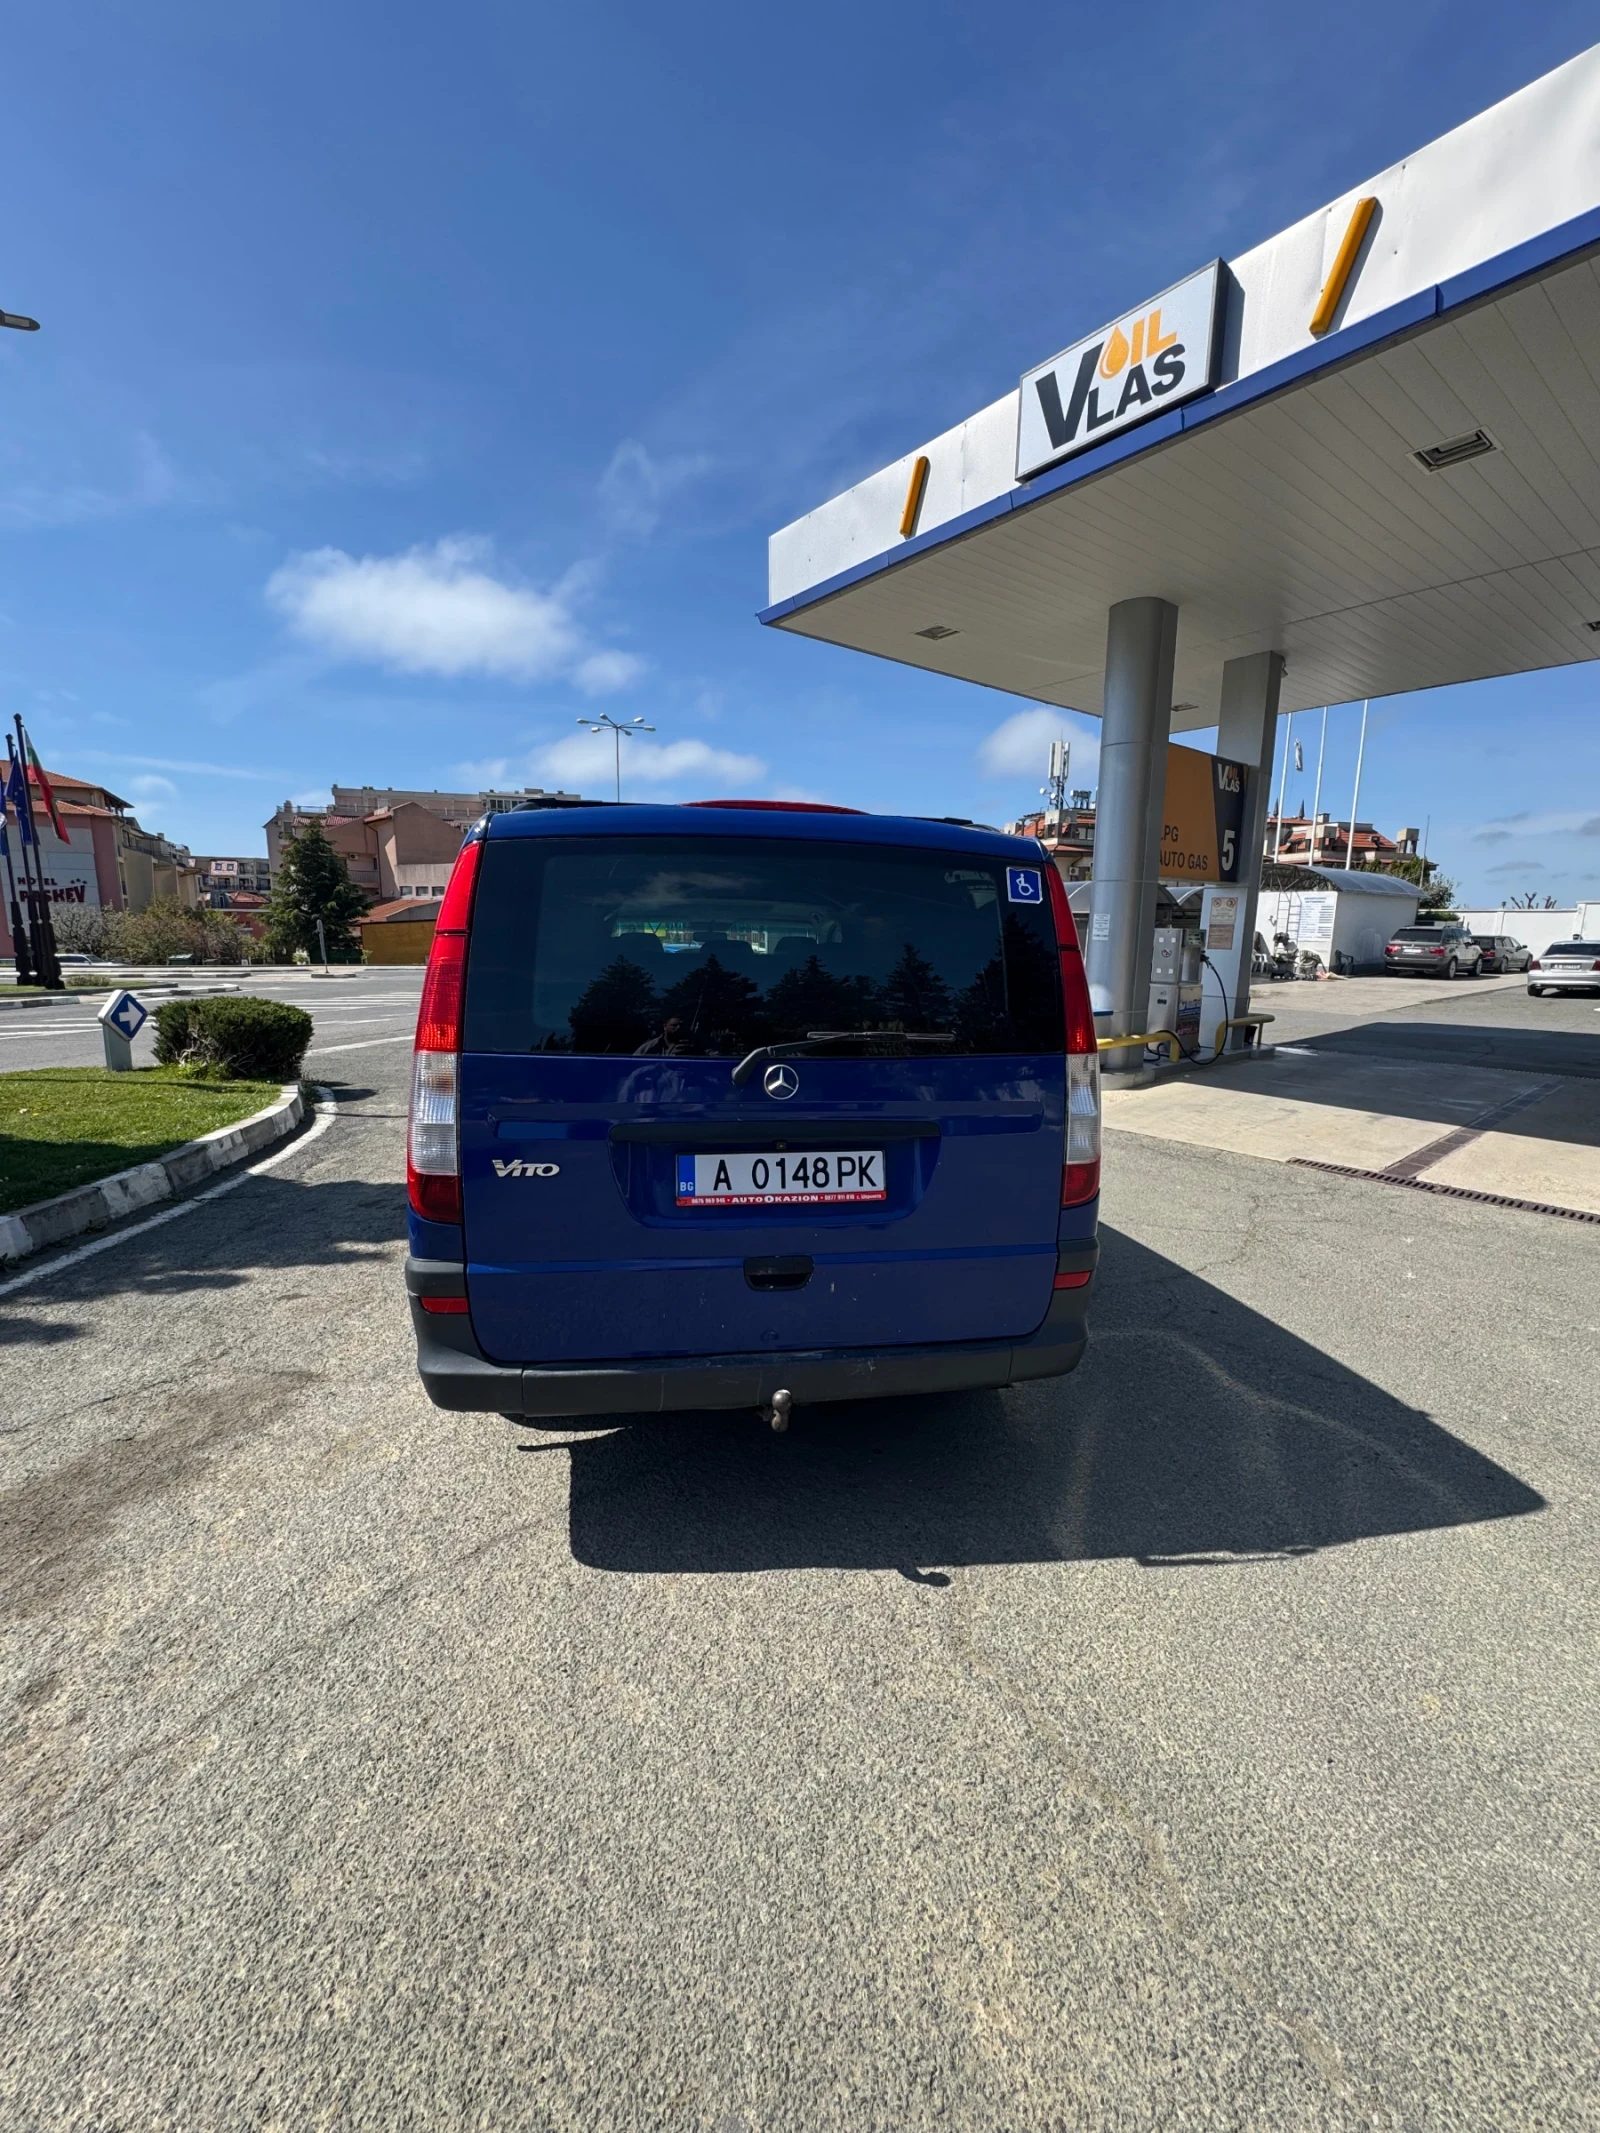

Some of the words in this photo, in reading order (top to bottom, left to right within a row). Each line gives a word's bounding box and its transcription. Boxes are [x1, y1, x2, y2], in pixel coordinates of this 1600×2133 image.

[1035, 341, 1186, 450] VLAS
[1217, 763, 1240, 793] VLAS
[1161, 825, 1179, 843] PG
[1188, 853, 1208, 870] GAS
[1221, 829, 1236, 871] 5
[17, 877, 57, 886] HOEL
[680, 1182, 694, 1192] BG
[713, 1159, 732, 1191] A
